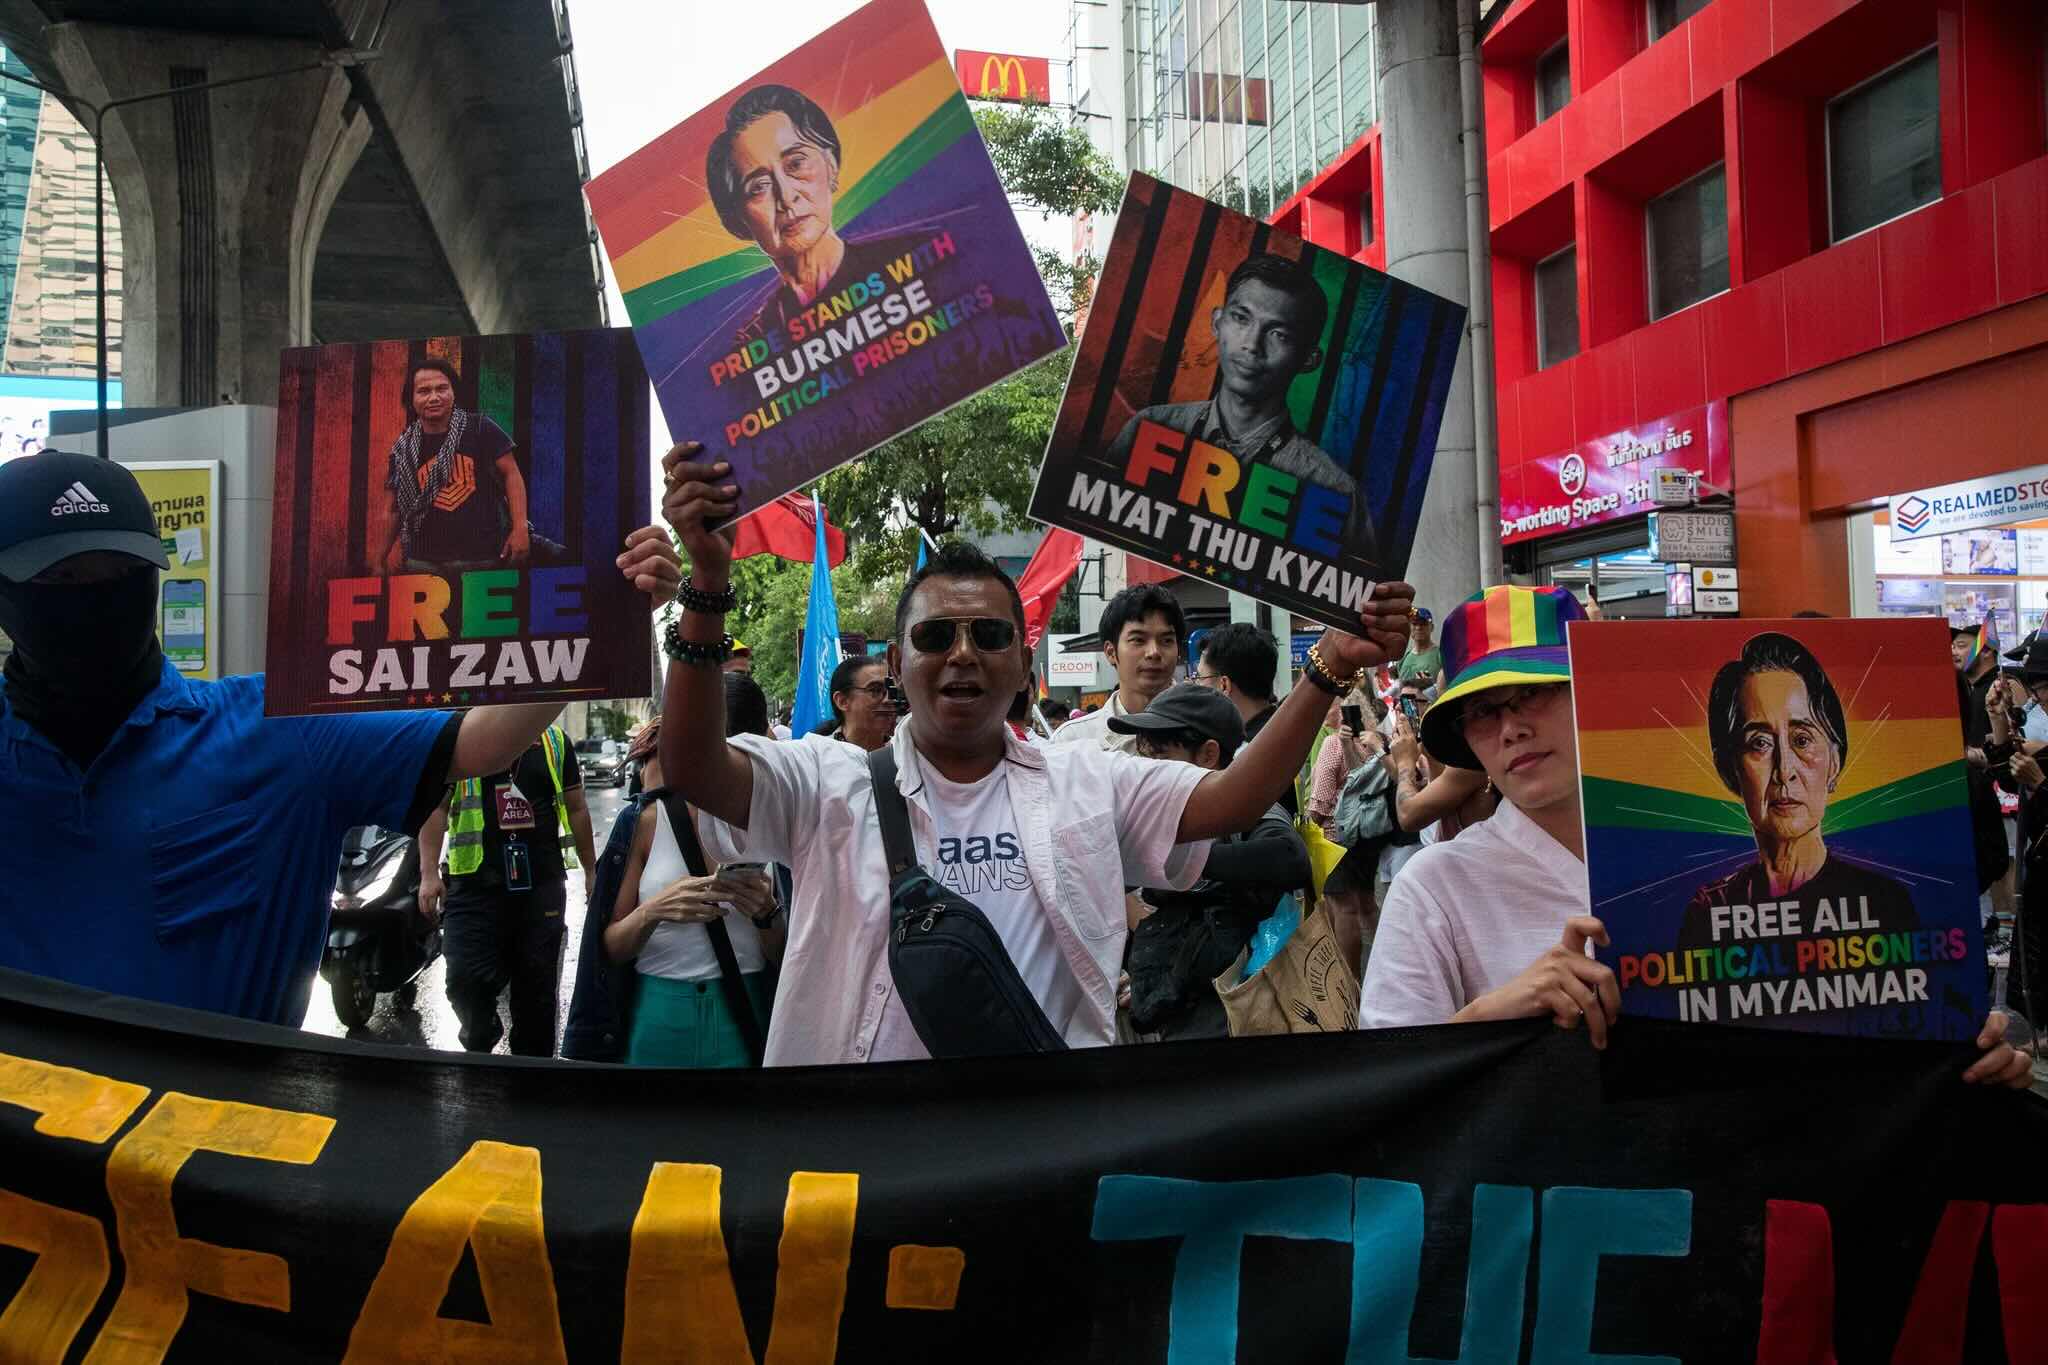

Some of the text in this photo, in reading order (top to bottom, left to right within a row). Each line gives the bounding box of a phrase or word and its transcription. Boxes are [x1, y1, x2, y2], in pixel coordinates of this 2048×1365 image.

[709, 231, 957, 387] PRIDE STANDS WITH
[725, 283, 994, 447] POLITICAL PRISONERS
[753, 279, 933, 400] BURMESE
[51, 501, 110, 517] adidas
[1124, 419, 1351, 560] FREE
[1572, 492, 1620, 522] Space
[1969, 504, 2005, 520] devoted
[2008, 504, 2017, 513] to
[1067, 472, 1377, 613] MYAT THU KYAW
[1687, 516, 1729, 526] STUDIO
[1687, 526, 1731, 537] SMILE
[327, 566, 590, 646] FREE
[328, 638, 591, 695] SAI ZAW
[502, 809, 531, 820] AREA
[505, 800, 527, 810] ALL
[1710, 895, 1880, 942] FREE ALL
[1619, 927, 1967, 990] POLITICAL PRISONERS
[1677, 968, 1929, 1023] IN MYANMAR
